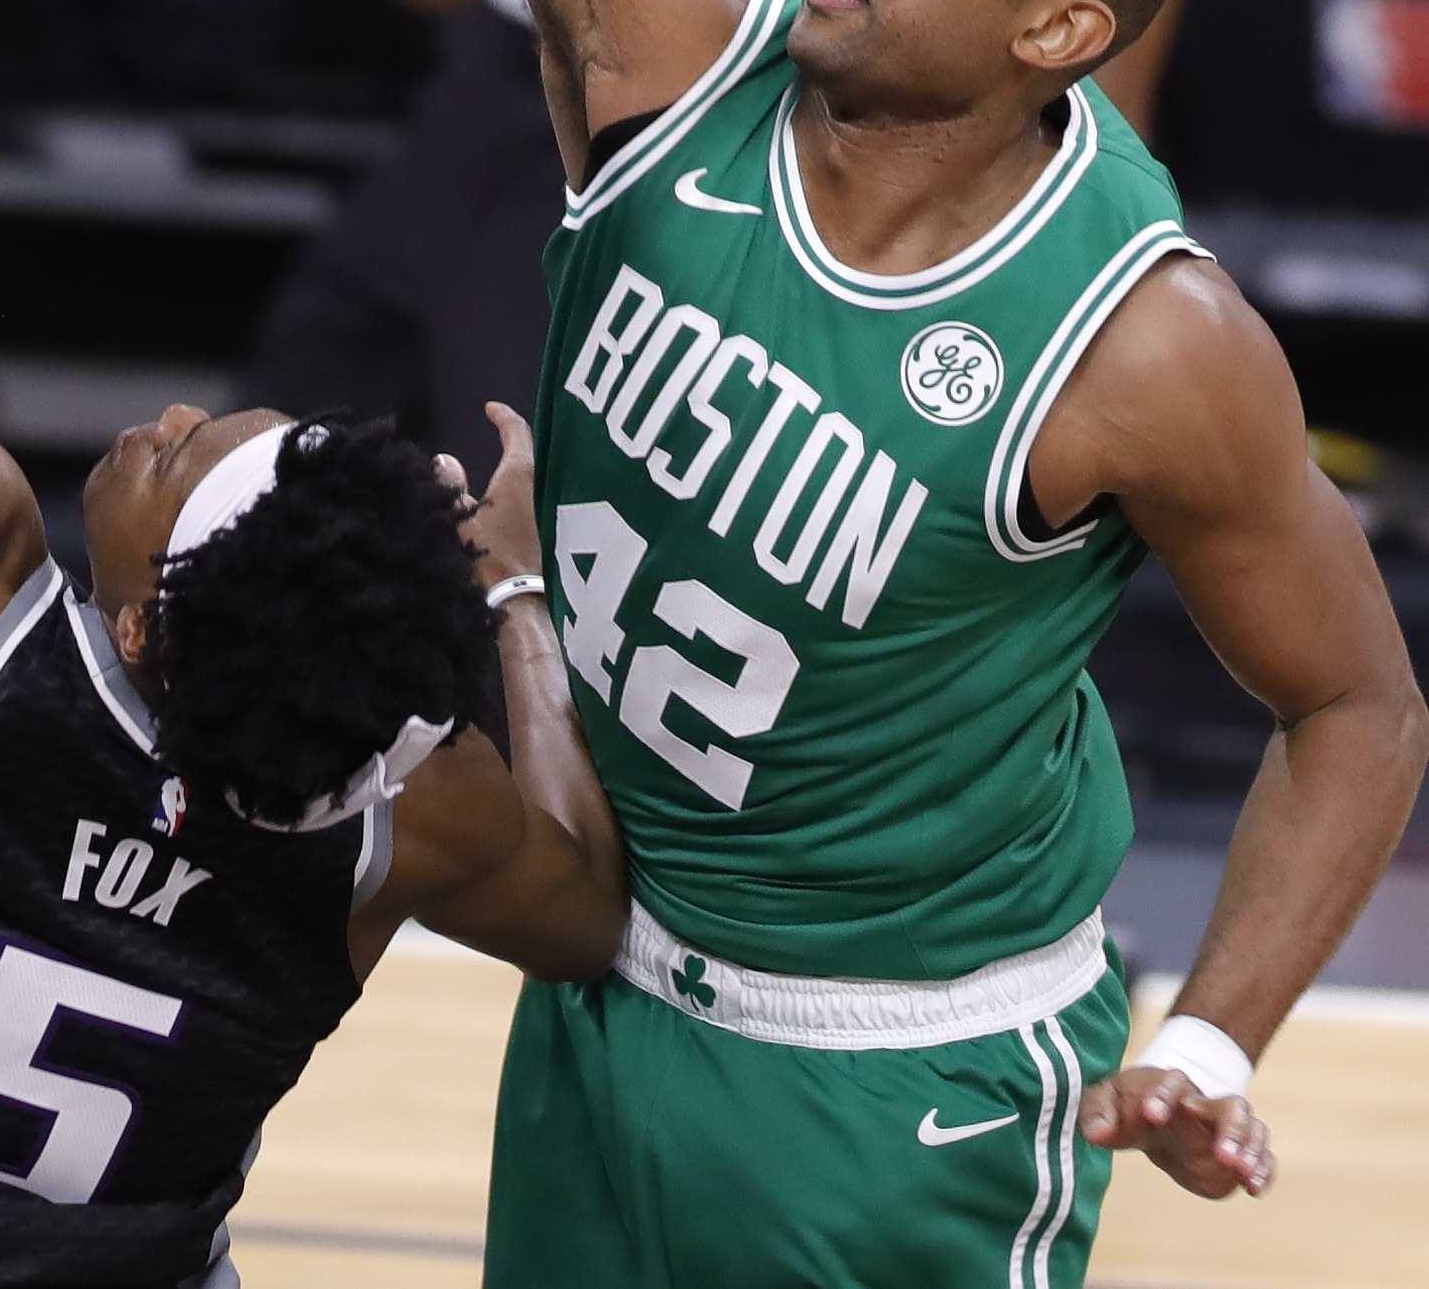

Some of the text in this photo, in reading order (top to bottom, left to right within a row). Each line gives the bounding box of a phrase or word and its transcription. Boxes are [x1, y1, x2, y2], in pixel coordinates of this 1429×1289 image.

[565, 263, 929, 630] BOSTON
[555, 501, 801, 812] 42
[62, 818, 213, 927] FOX
